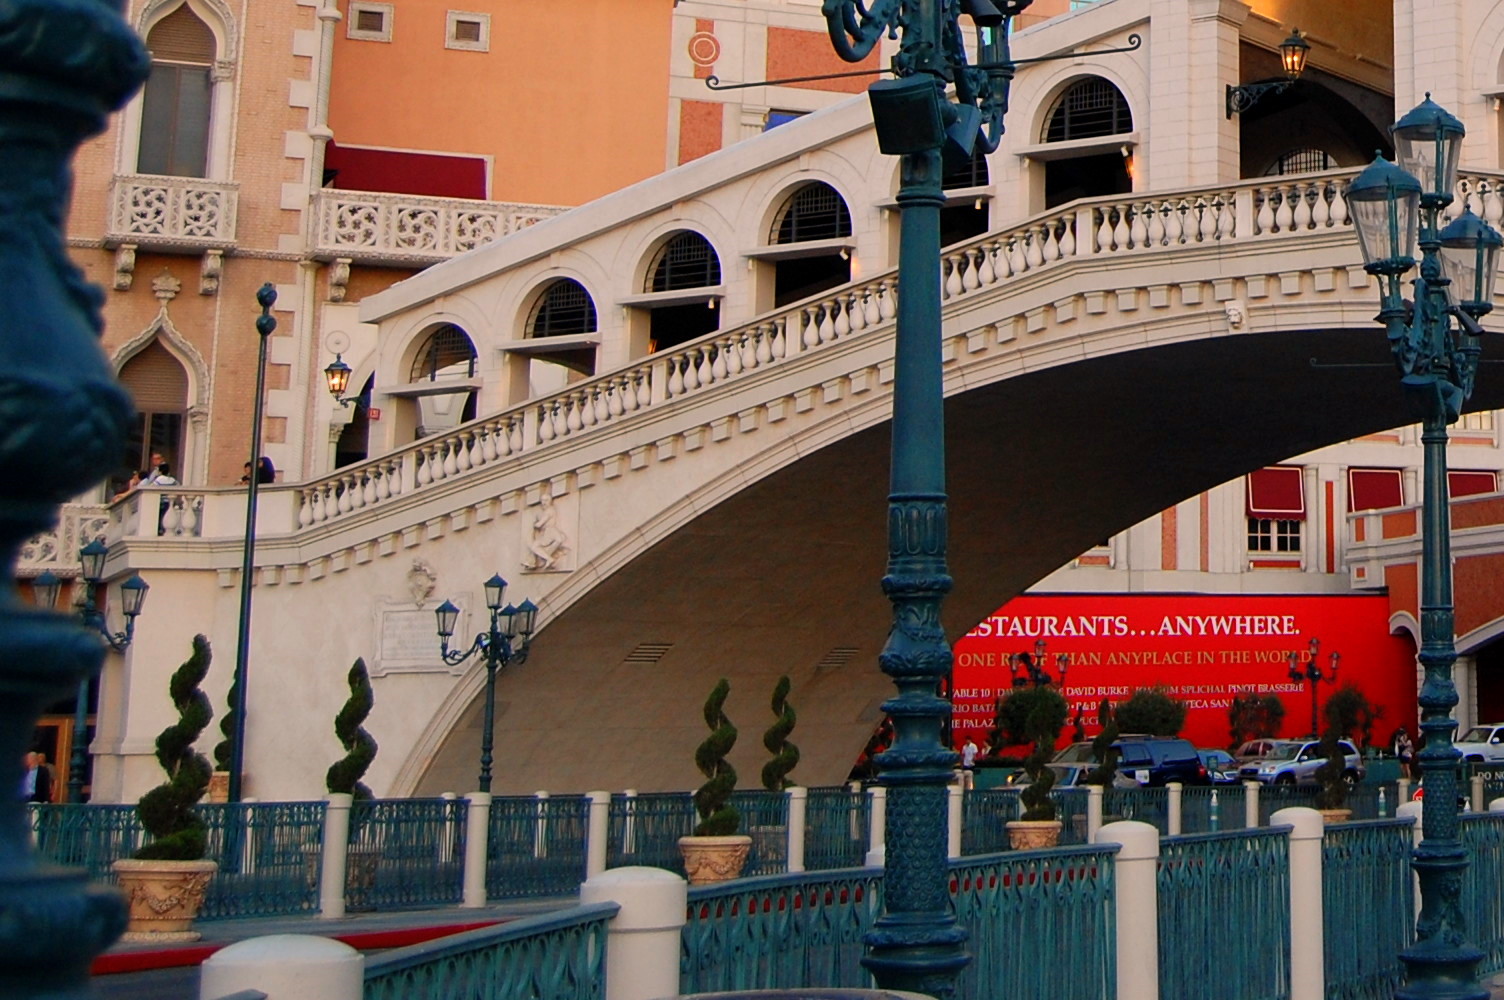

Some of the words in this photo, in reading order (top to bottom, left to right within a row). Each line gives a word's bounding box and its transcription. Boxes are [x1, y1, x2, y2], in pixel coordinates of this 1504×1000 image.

[958, 653, 996, 667] ONE
[1001, 652, 1048, 666] ROF
[1106, 651, 1192, 665] ANYPLACE
[1197, 651, 1215, 664] IN
[1218, 650, 1250, 664] THE
[1254, 649, 1312, 664] WORD
[952, 688, 979, 698] ABLE
[1066, 686, 1095, 696] DAVID
[1097, 685, 1129, 696] BURKE
